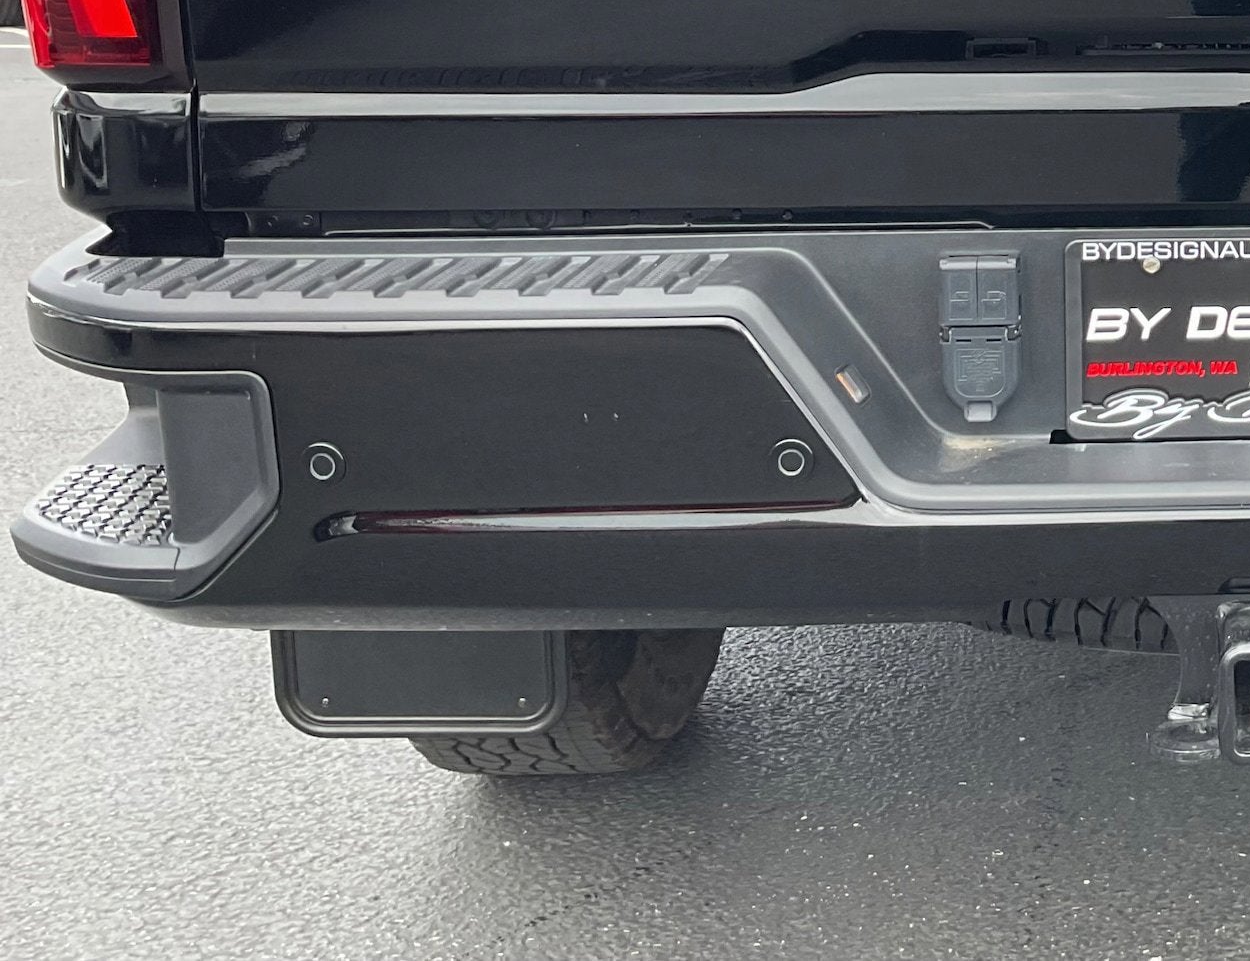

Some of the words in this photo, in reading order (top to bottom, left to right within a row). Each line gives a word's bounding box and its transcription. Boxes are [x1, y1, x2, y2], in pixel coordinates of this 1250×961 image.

[1086, 307, 1171, 342] BY
[1086, 360, 1206, 378] BURLINGTON,
[1211, 360, 1239, 376] WA
[1069, 390, 1202, 440] By
